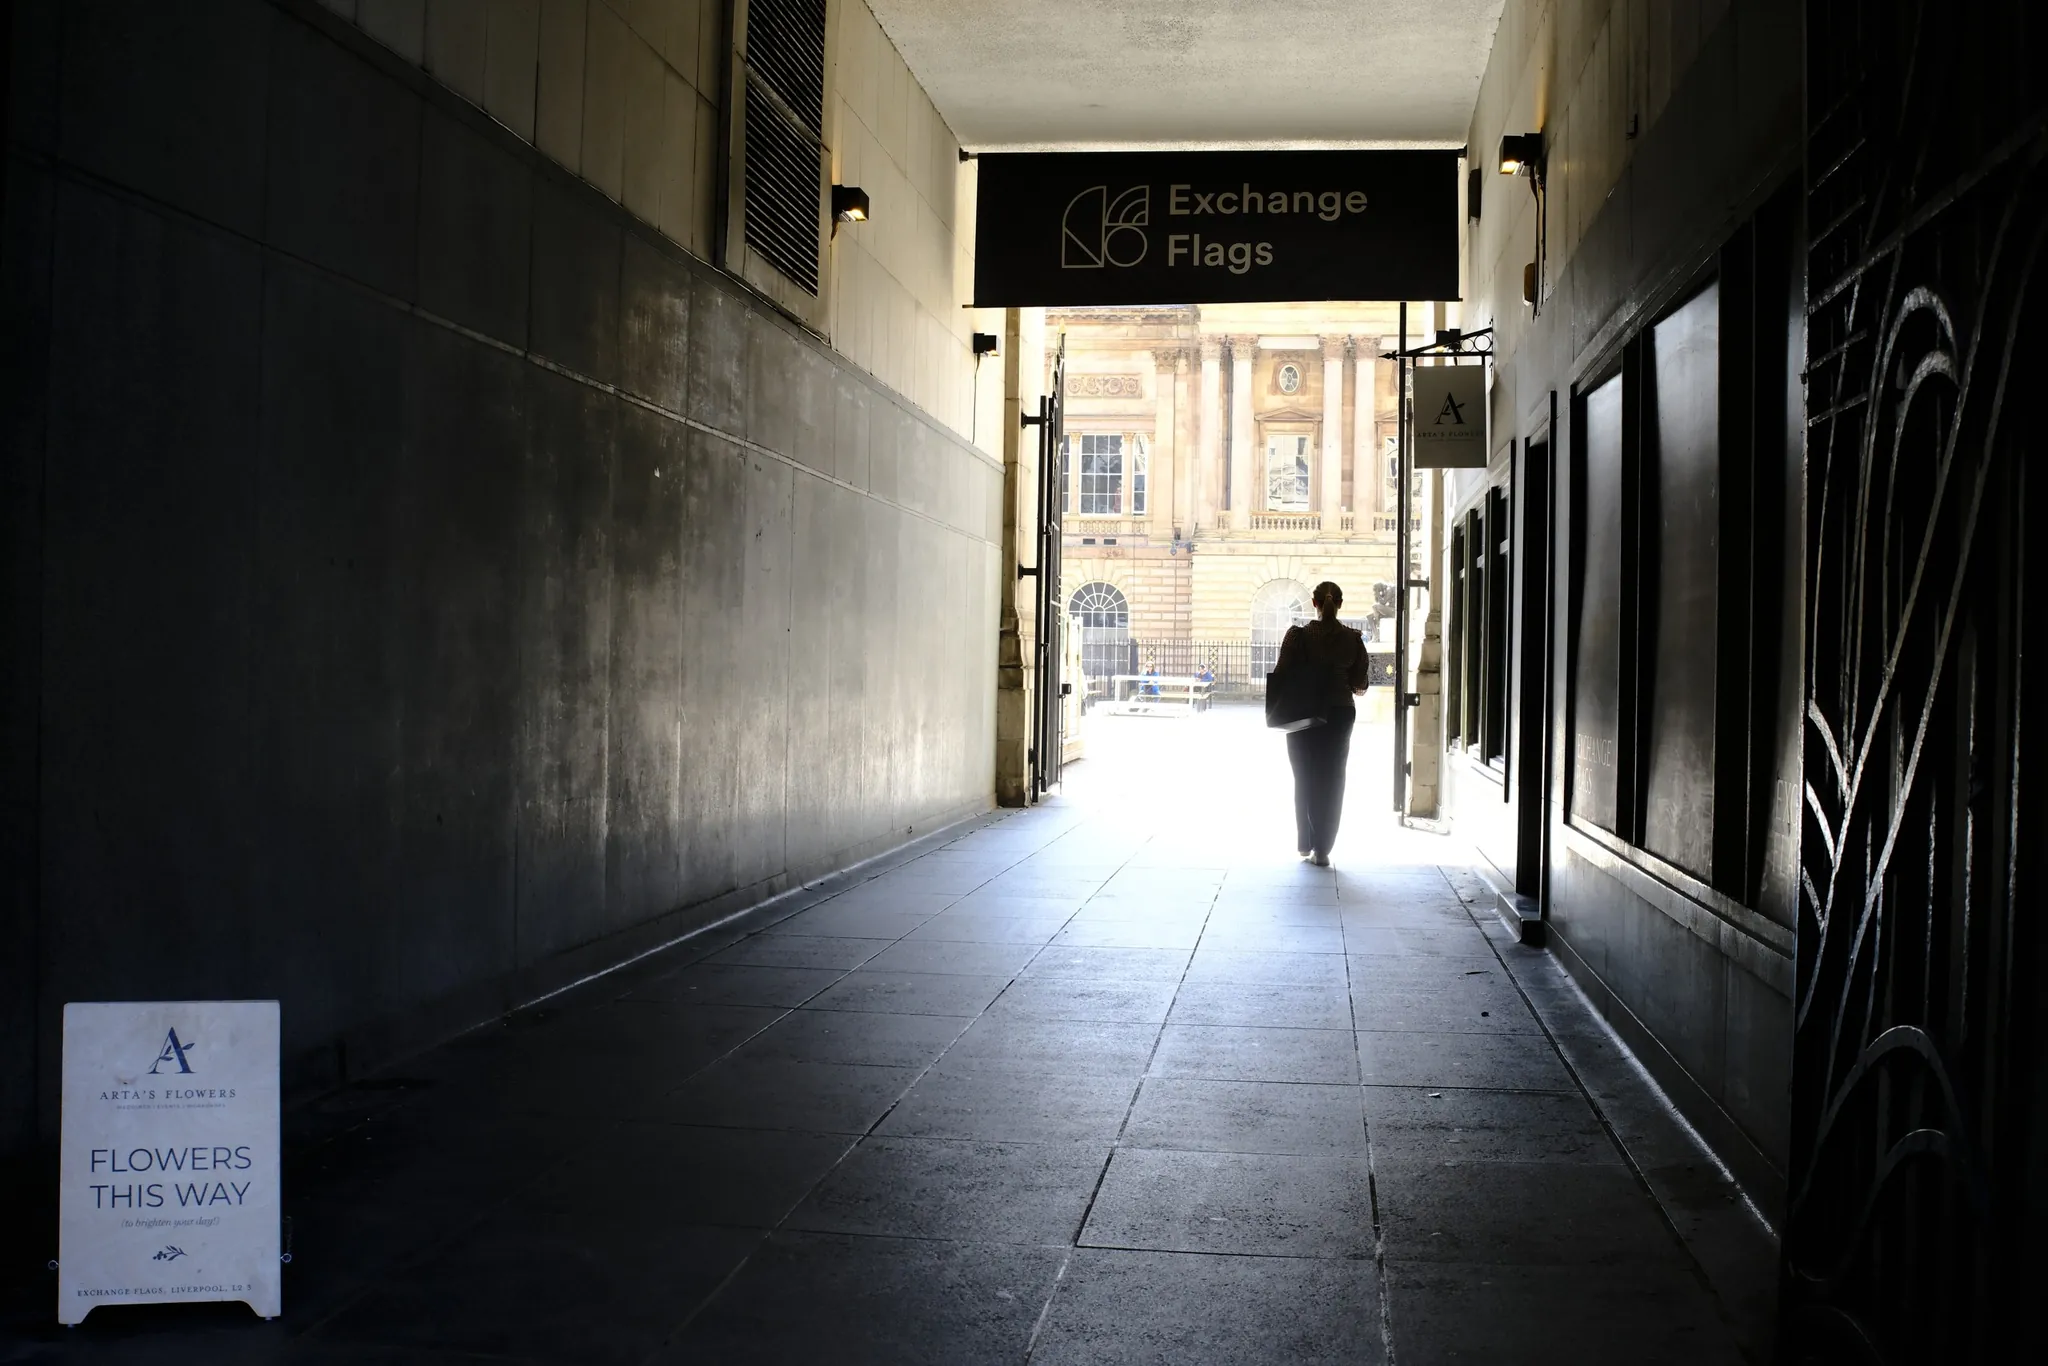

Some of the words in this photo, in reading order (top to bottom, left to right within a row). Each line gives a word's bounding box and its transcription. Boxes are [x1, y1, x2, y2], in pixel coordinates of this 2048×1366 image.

[1168, 183, 1369, 222] Exchange
[1167, 233, 1275, 275] Flags
[1433, 391, 1466, 425] A
[146, 1026, 196, 1075] A
[99, 1090, 157, 1100] ARTA'S
[165, 1088, 237, 1099] FLOWERS
[90, 1145, 253, 1174] FLOWERS
[89, 1183, 165, 1209] THIS
[174, 1181, 252, 1207] WAY
[121, 1218, 134, 1229] (to
[135, 1217, 172, 1230] brighten
[173, 1218, 195, 1230] your
[195, 1215, 221, 1228] day!)
[77, 1286, 131, 1297] EXCHANGE
[133, 1285, 167, 1295] FLAGS,
[170, 1284, 228, 1294] LIVERPOOL,
[232, 1284, 244, 1292] L2
